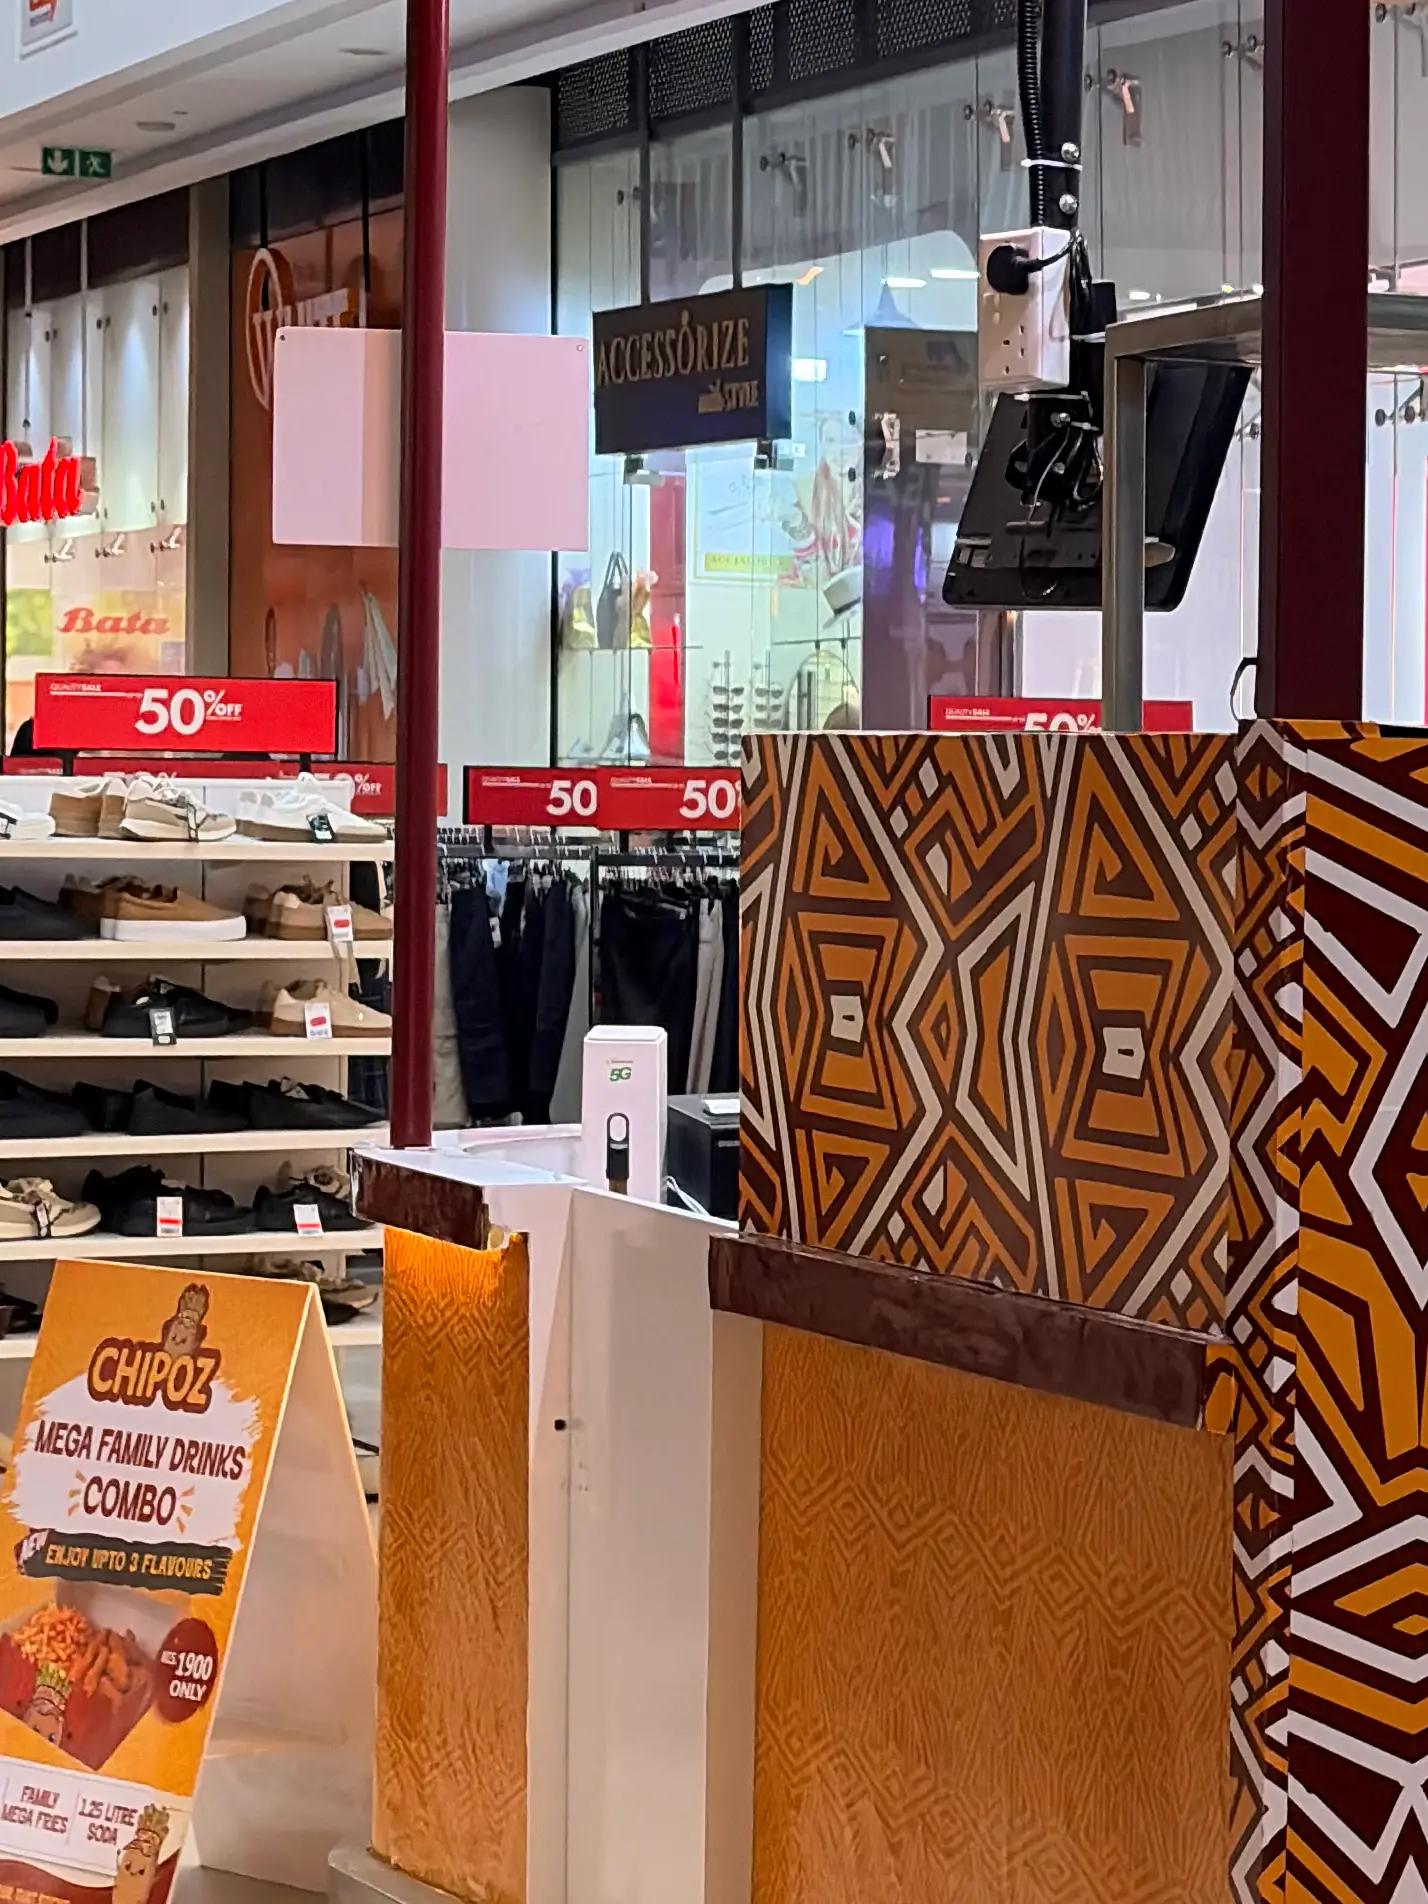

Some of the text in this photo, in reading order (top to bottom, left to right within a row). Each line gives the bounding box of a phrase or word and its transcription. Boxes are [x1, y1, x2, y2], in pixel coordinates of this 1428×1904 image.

[596, 310, 750, 387] ACCESSORIZE
[57, 607, 170, 635] Bata
[679, 779, 742, 819] 50
[609, 1067, 632, 1081] 5G
[92, 1346, 216, 1405] CHIPOZ
[34, 1420, 246, 1481] MEGA FAMILY DRINKS
[83, 1475, 177, 1526] COMBO
[45, 1544, 213, 1580] ENJOY UPTO 3 FLAVOURS
[175, 1652, 213, 1681] 1900
[169, 1679, 207, 1701] ONLY
[86, 1822, 118, 1846] SODA
